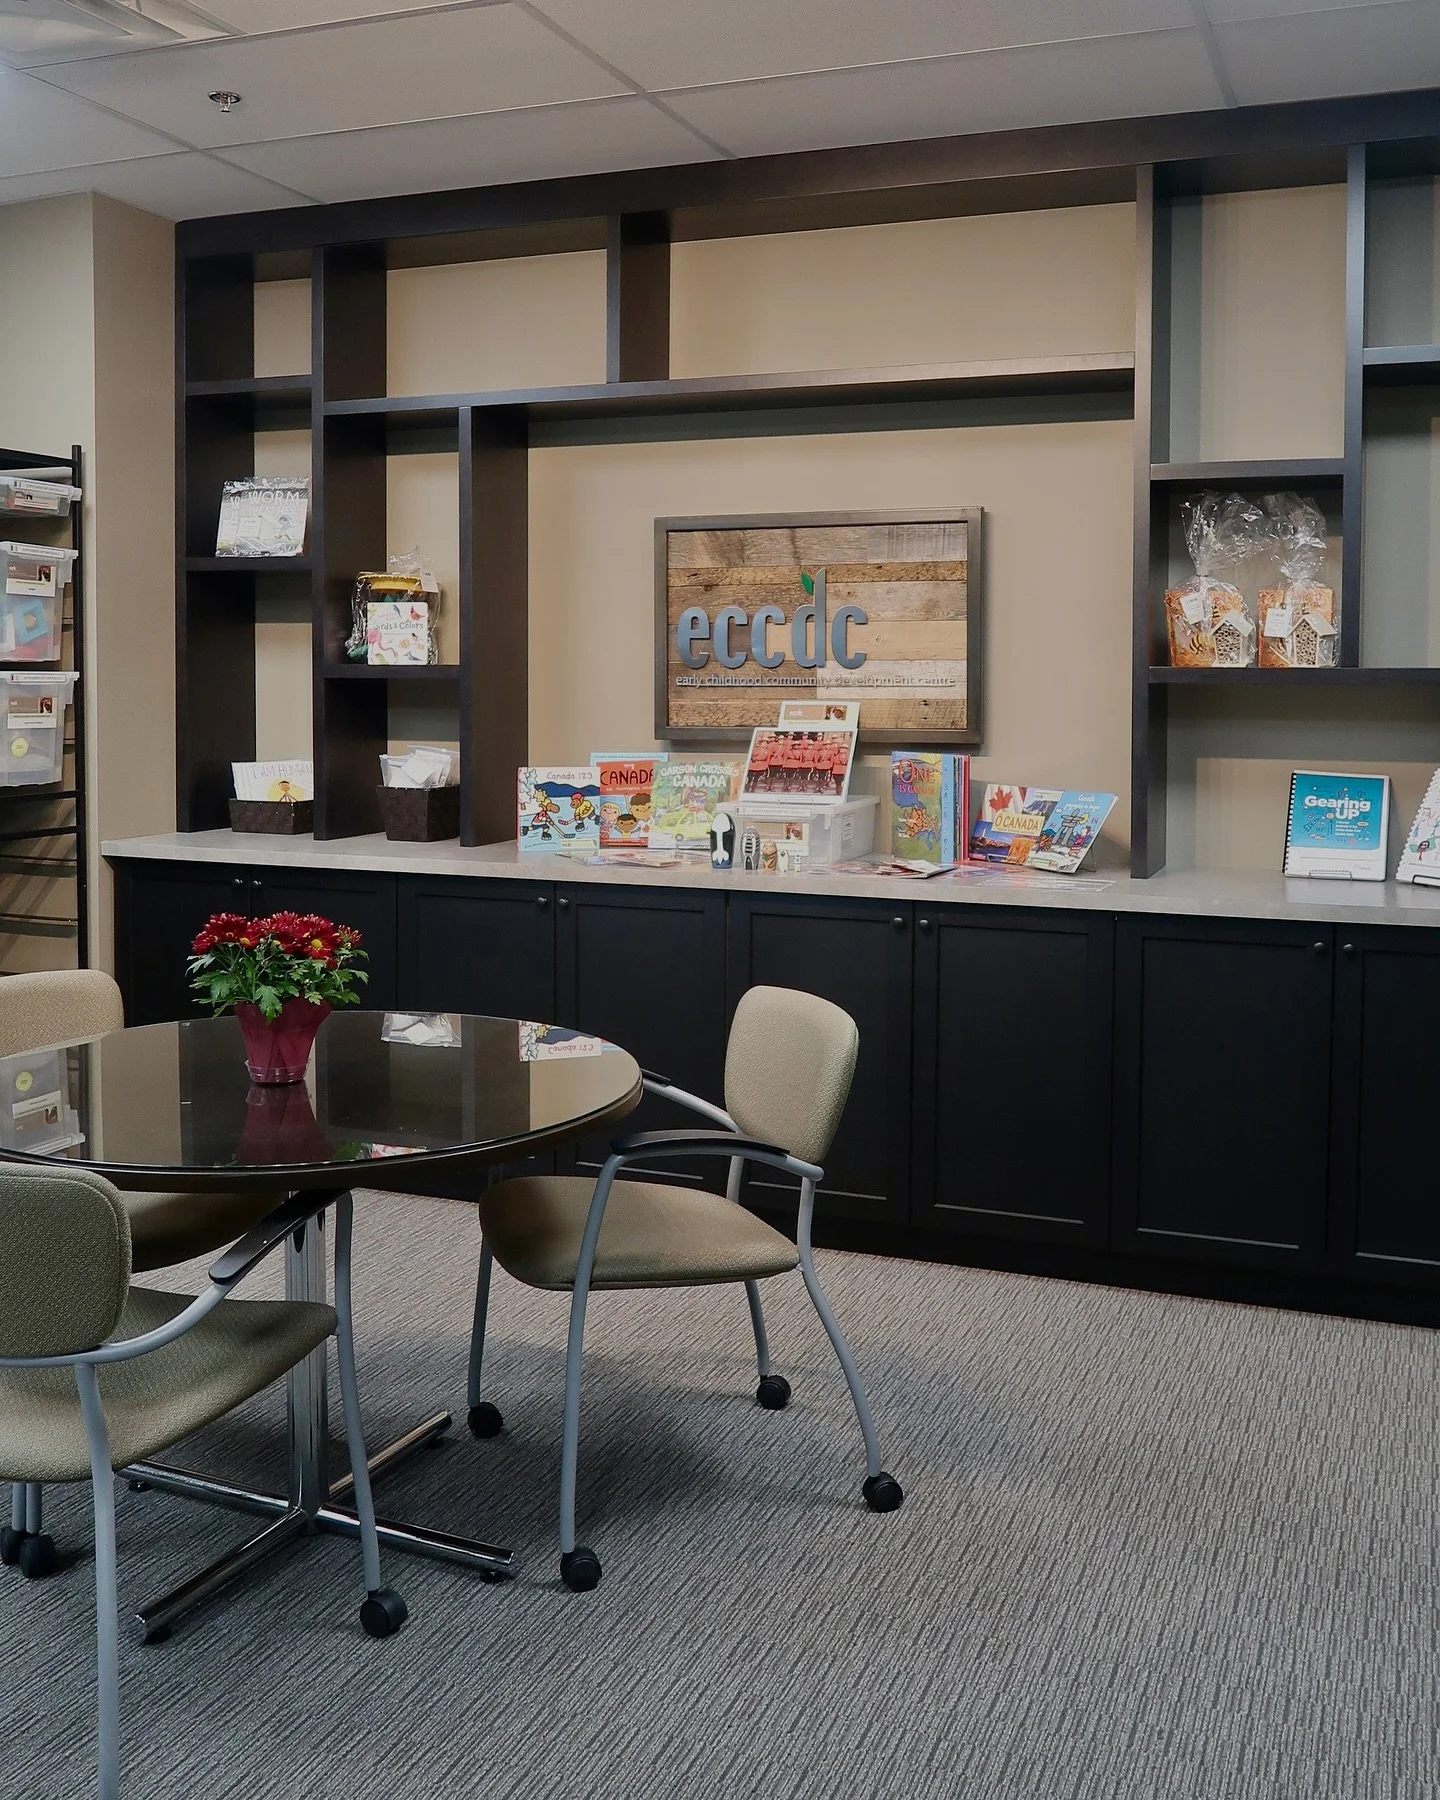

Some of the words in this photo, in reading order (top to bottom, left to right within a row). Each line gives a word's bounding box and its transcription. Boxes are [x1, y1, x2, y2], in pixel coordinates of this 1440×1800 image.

[249, 491, 300, 505] WORM
[676, 567, 868, 669] eccdc
[399, 620, 424, 630] Colors
[676, 674, 702, 688] early
[706, 674, 763, 686] childhood
[766, 674, 831, 689] community
[834, 674, 913, 689] development
[917, 675, 957, 688] centre
[261, 764, 276, 777] AM
[546, 771, 575, 780] Canada
[578, 772, 593, 780] 123
[660, 764, 697, 777] CARSON
[699, 764, 740, 777] CROSSES
[898, 758, 936, 784] ONE
[672, 774, 727, 788] CANADA
[899, 785, 907, 793] IS
[907, 785, 936, 795] CANADA
[1304, 794, 1371, 812] Gearing
[995, 815, 1003, 827] O
